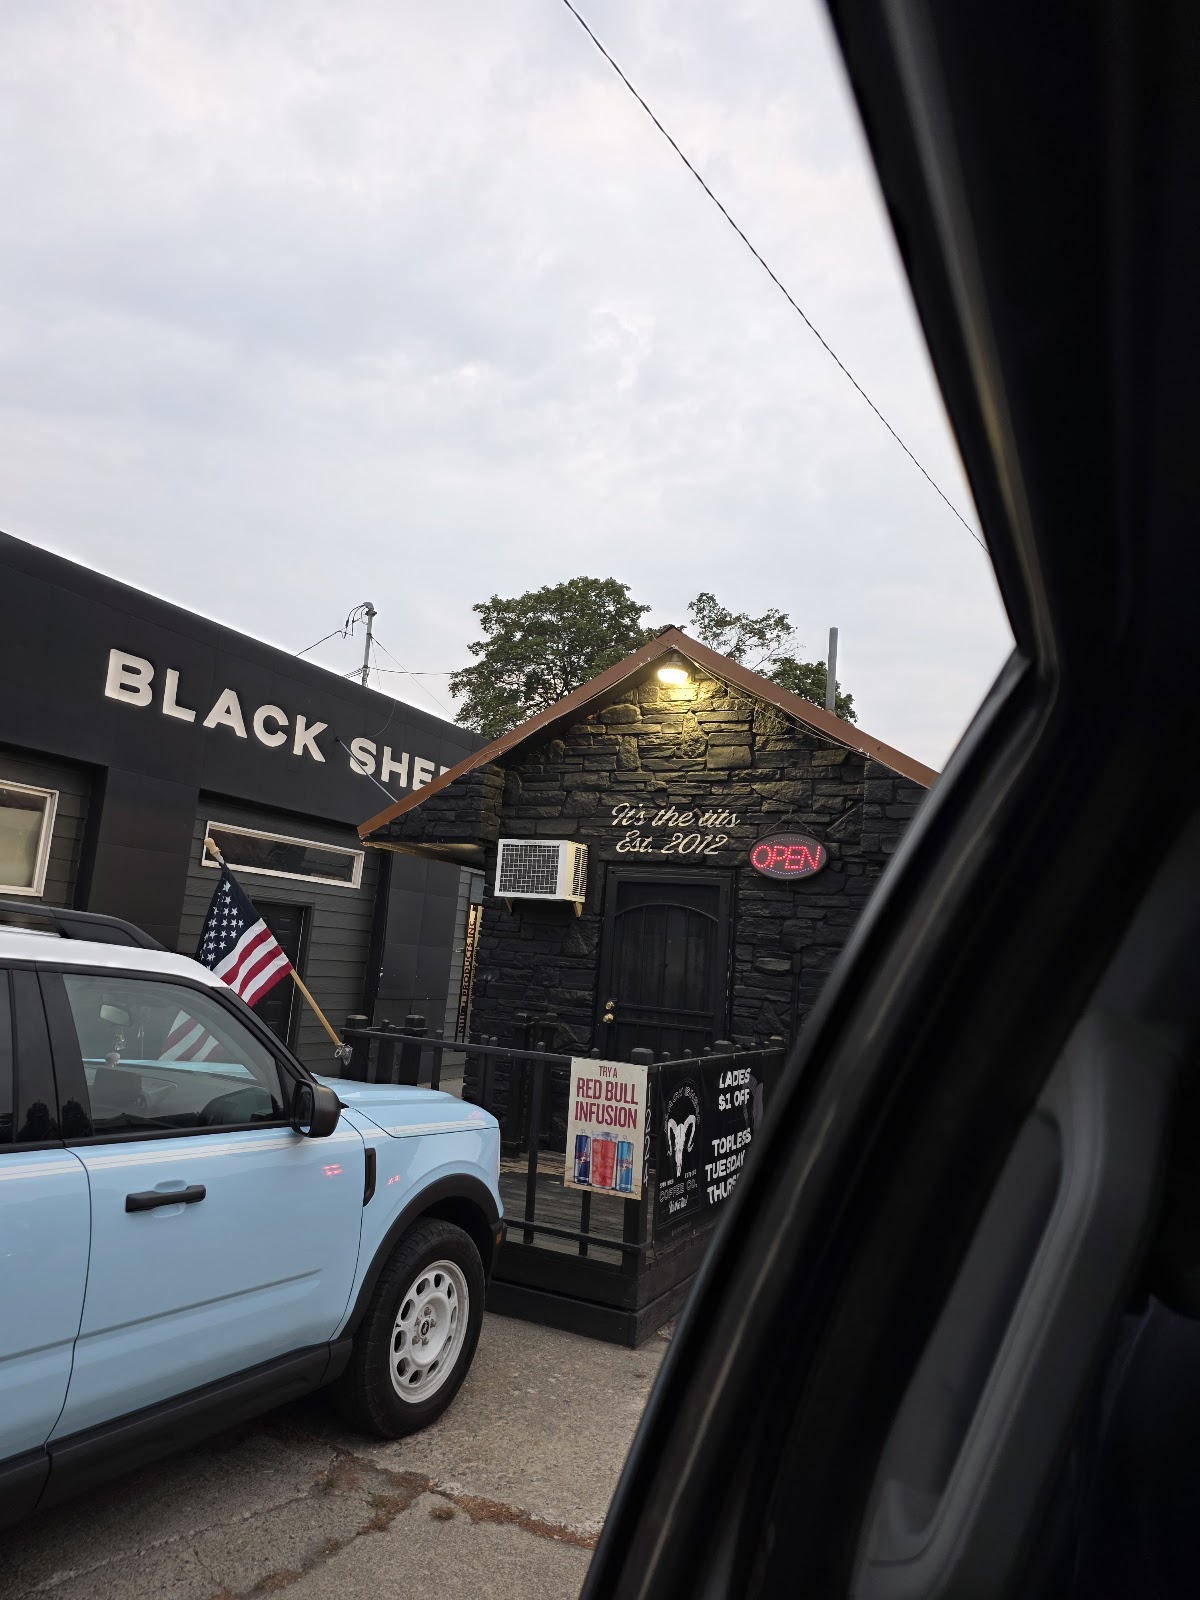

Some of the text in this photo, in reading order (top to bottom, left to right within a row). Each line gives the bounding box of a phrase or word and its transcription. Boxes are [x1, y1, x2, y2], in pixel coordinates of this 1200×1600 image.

[104, 648, 329, 763] BLACK
[611, 802, 740, 828] It's the tits
[616, 830, 728, 855] Est. 2012
[752, 845, 821, 869] OPEN
[599, 1065, 618, 1078] TRY A
[576, 1077, 639, 1105] RED BULL
[718, 1089, 750, 1112] $1 OFF
[574, 1101, 638, 1130] INFUSION
[643, 1082, 652, 1187] 1224
[711, 1128, 752, 1156] TOPLESS
[659, 1183, 685, 1203] COFFEE
[707, 1173, 740, 1204] THURS
